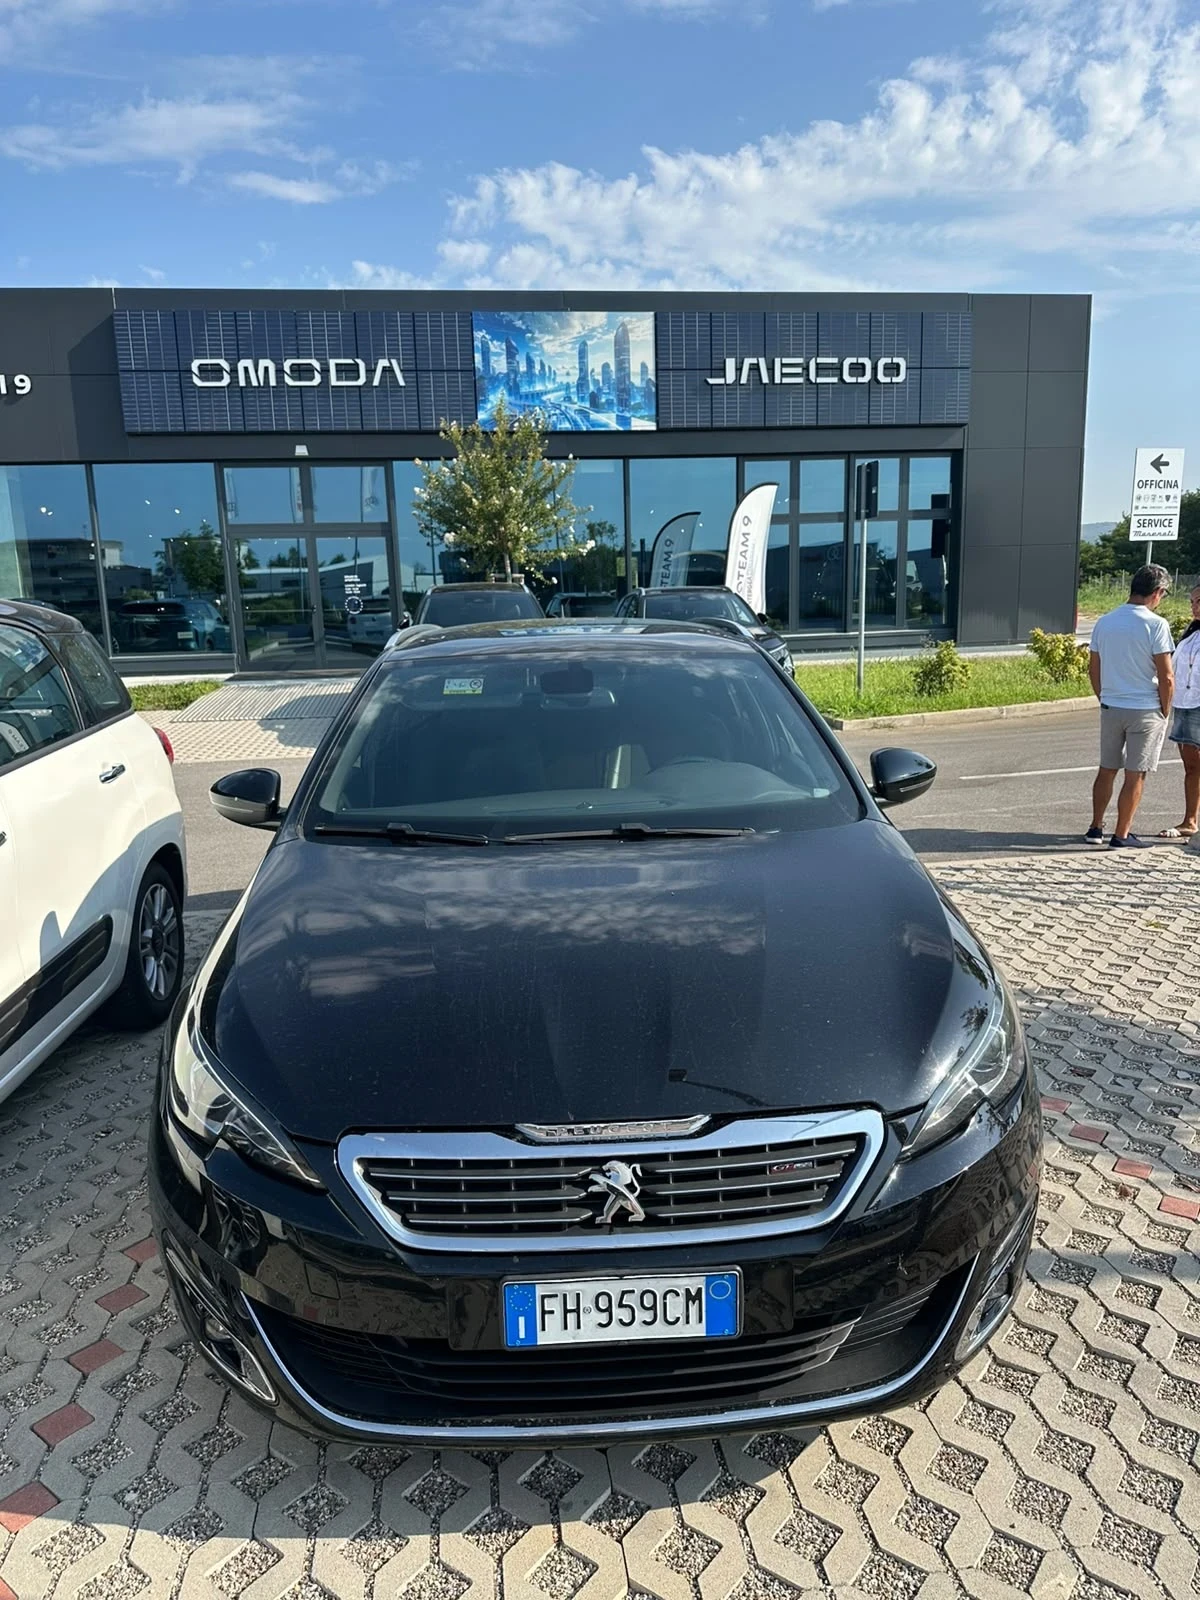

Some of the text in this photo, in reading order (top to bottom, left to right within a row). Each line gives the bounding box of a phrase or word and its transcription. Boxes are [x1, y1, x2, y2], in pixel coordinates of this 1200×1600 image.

[191, 358, 406, 387] OMODA
[705, 357, 907, 385] JAECOO
[1136, 479, 1179, 489] OFFICINA
[742, 515, 753, 528] 9
[1136, 518, 1174, 528] SERVICE
[664, 538, 674, 547] 9
